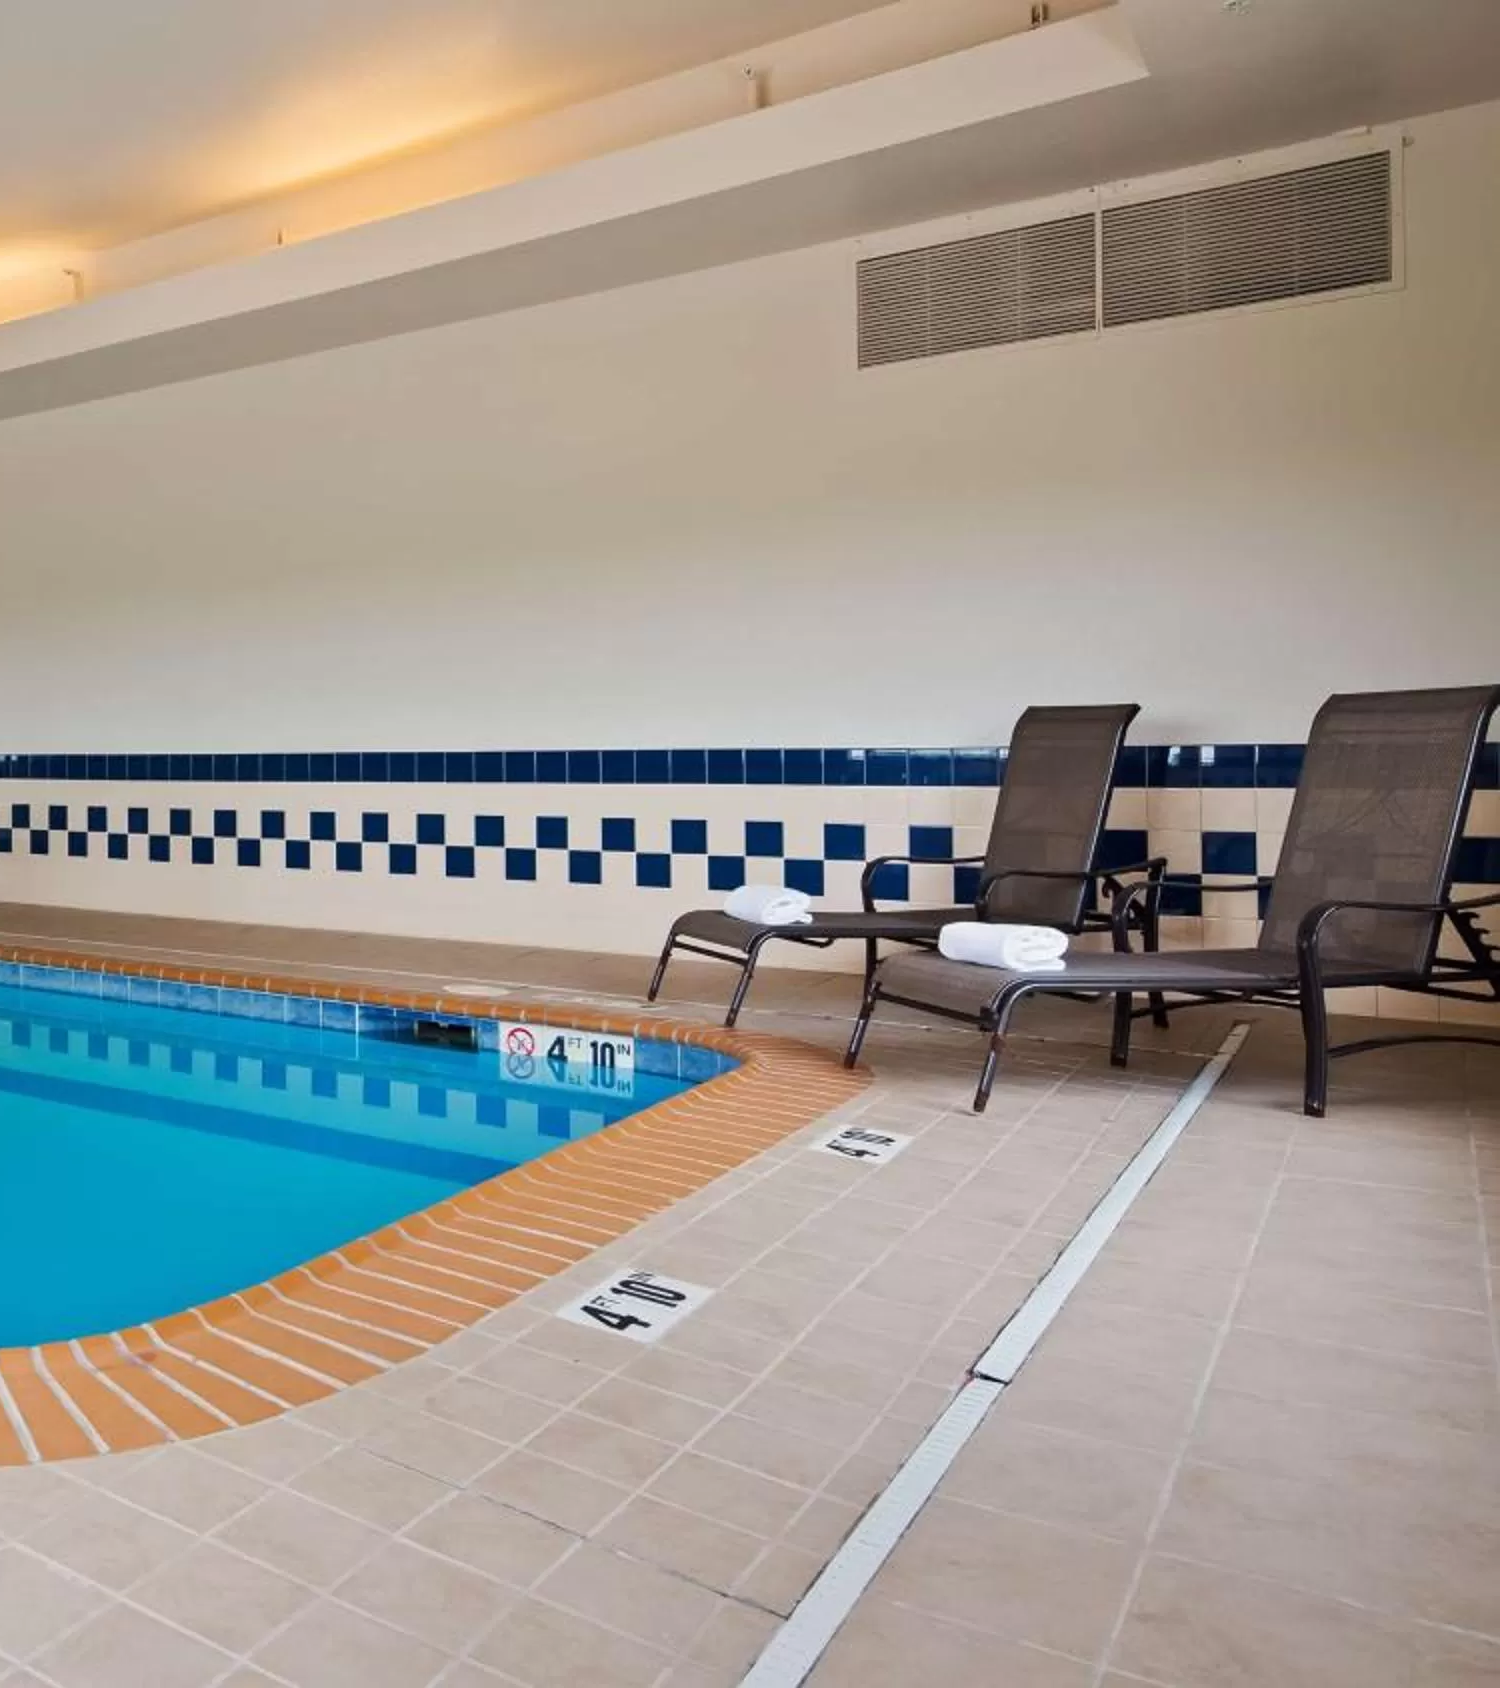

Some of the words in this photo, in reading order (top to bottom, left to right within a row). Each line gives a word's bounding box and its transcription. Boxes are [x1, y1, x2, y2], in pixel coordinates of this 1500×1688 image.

[547, 1035, 568, 1061] 4
[568, 1037, 583, 1049] FT
[589, 1040, 615, 1068] 10
[617, 1043, 631, 1056] IN
[610, 1279, 686, 1308] 10
[580, 1305, 652, 1331] 4
